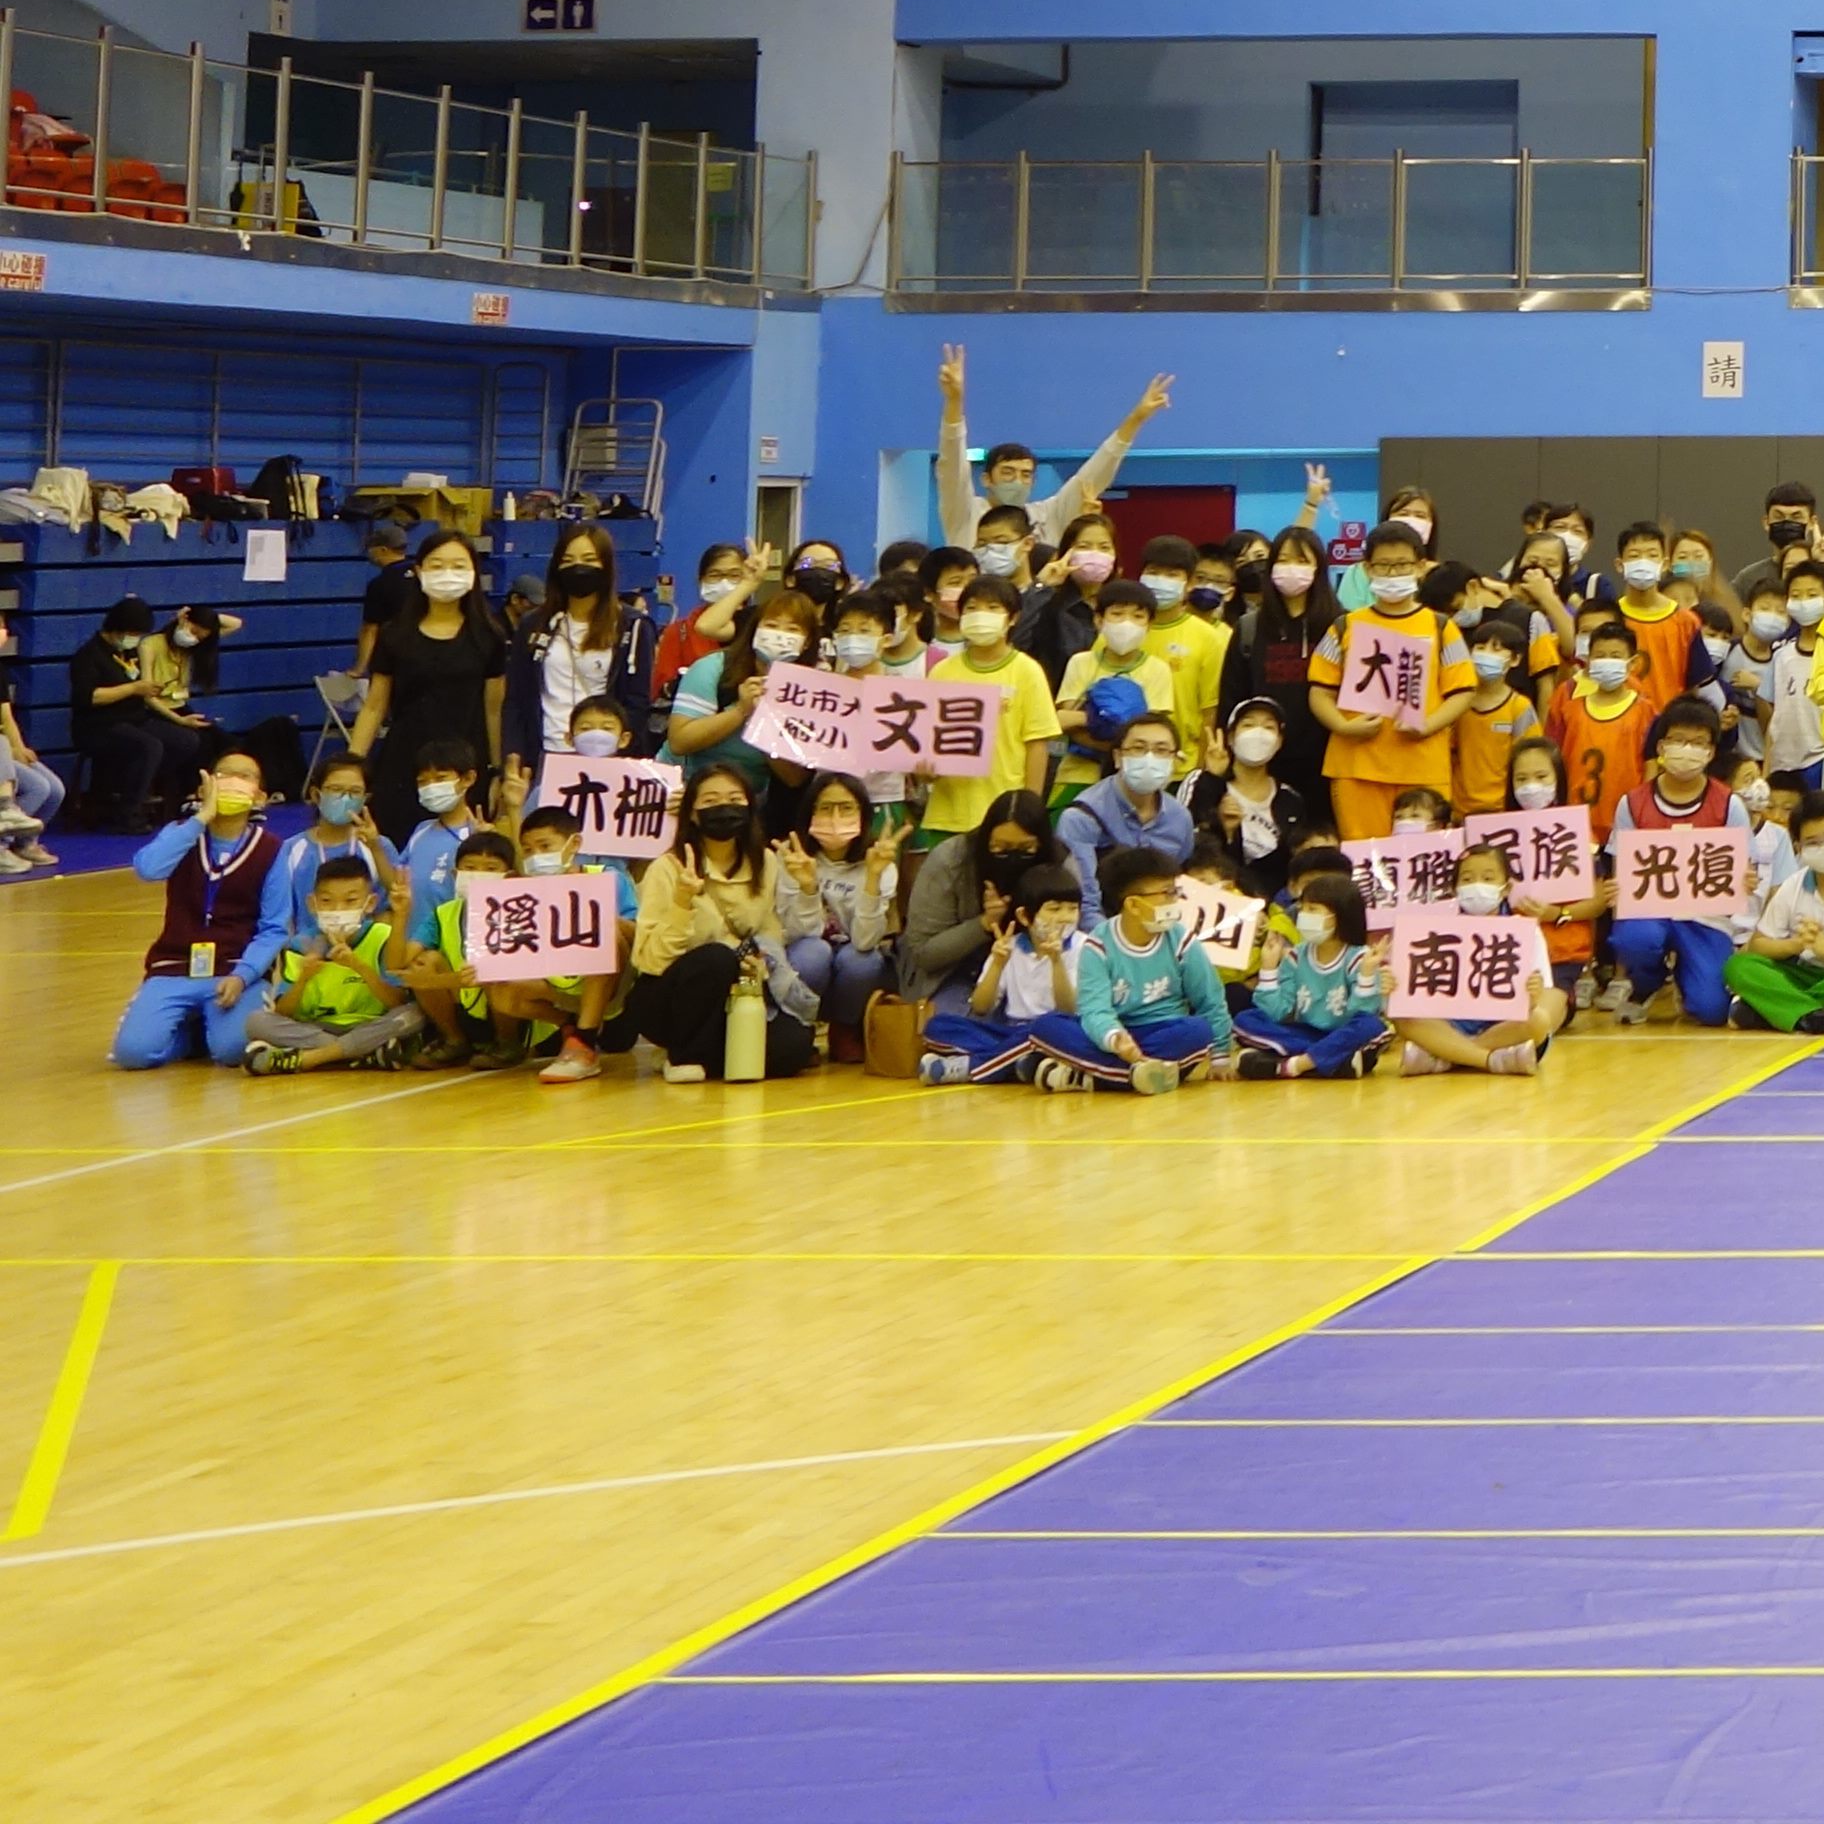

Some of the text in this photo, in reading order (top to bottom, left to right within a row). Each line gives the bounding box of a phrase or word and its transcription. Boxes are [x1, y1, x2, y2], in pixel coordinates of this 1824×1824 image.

[1706, 354, 1742, 389] 請
[1355, 638, 1424, 711] 大龍
[871, 691, 989, 758] 文昌
[559, 772, 667, 839] 木柵
[1578, 748, 1605, 805] 3
[1631, 842, 1737, 901] 光復
[484, 890, 601, 956] 溪山
[1407, 931, 1521, 1000] 南港
